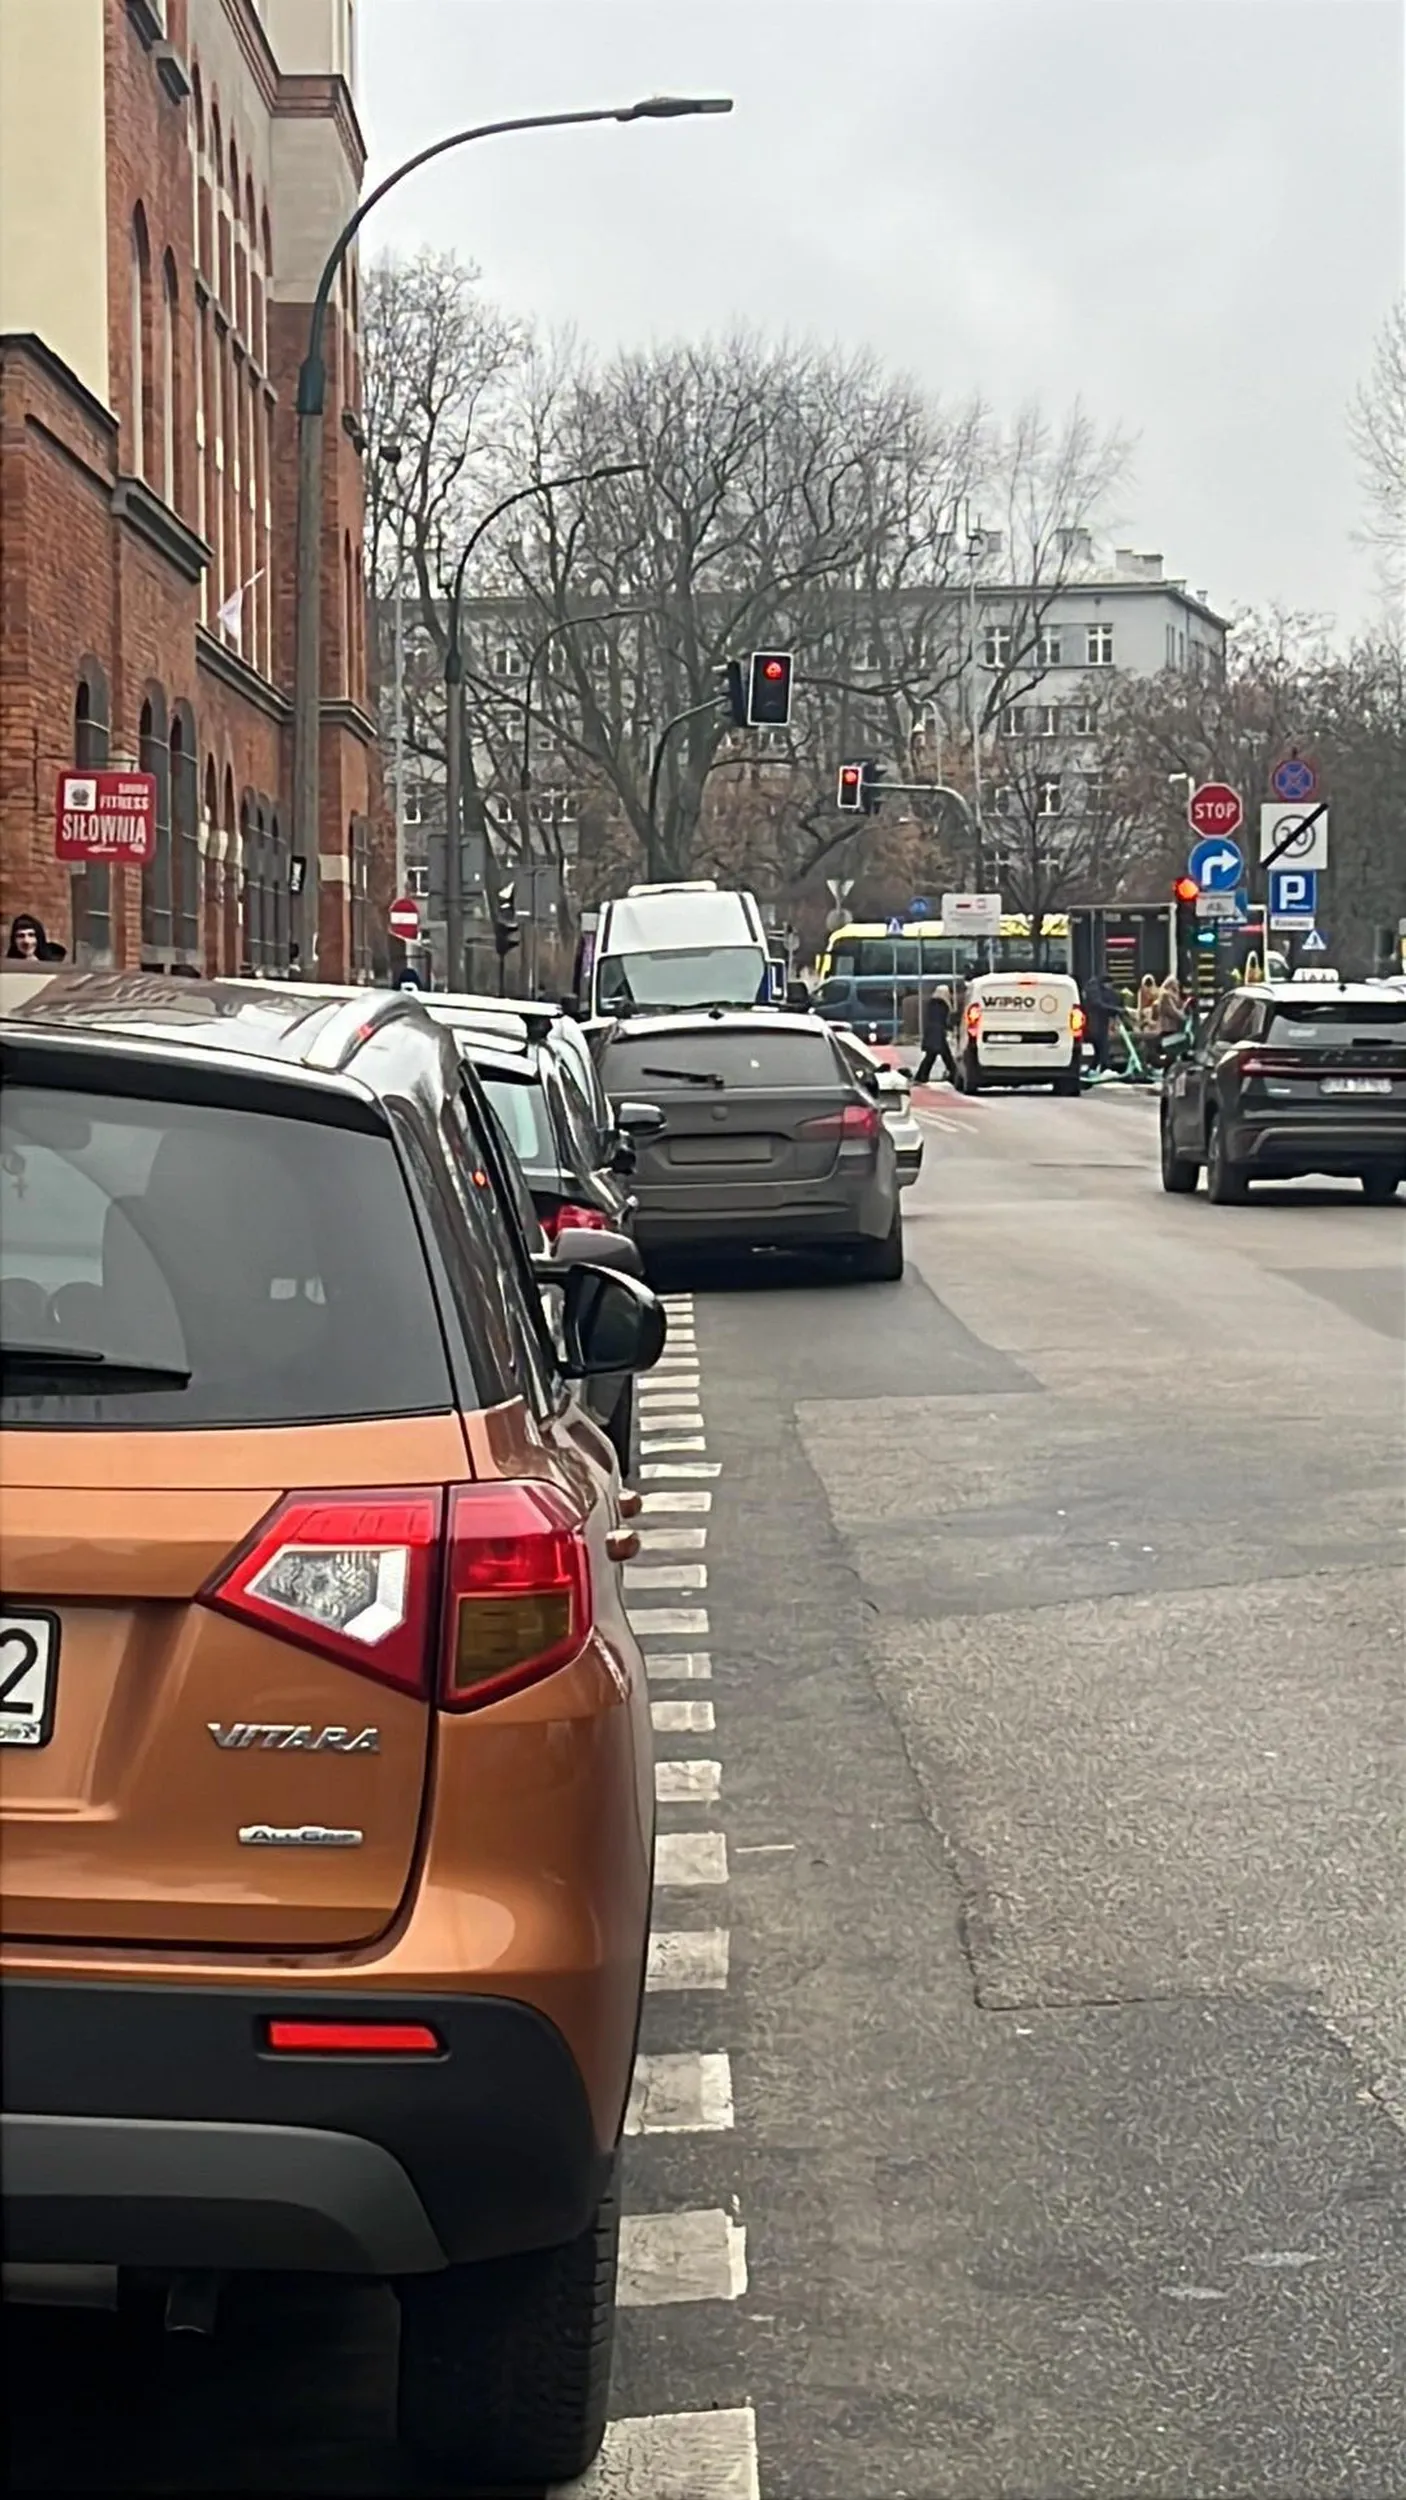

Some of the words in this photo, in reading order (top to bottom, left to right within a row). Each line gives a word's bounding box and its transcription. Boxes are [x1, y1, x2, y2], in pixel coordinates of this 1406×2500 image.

[100, 795, 148, 810] FITNESS
[1194, 802, 1237, 819] STOP
[62, 813, 146, 844] SIŁOWNIA
[1279, 876, 1306, 910] P
[982, 996, 1035, 1008] WIPRO
[207, 1723, 379, 1752] VITARA
